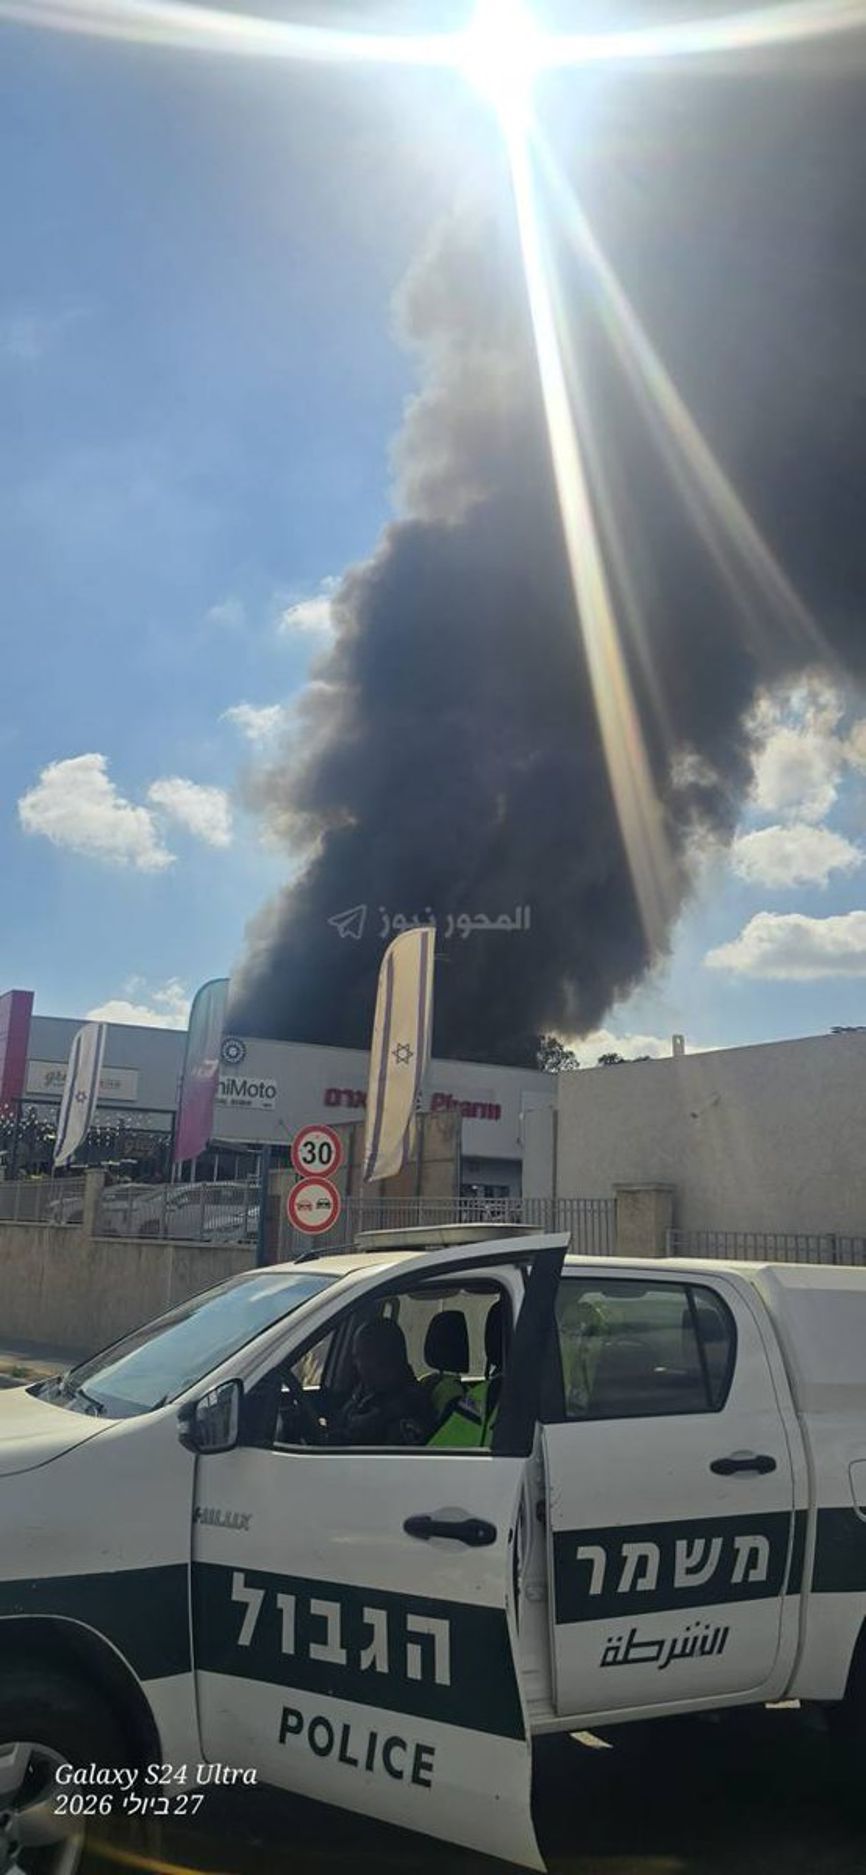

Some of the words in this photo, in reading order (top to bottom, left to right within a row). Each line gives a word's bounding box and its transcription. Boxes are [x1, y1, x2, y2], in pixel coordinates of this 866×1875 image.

[218, 1079, 276, 1099] niMoto
[325, 1088, 368, 1108] ארם
[302, 1141, 332, 1165] 30
[576, 1534, 770, 1596] משמר
[231, 1571, 451, 1687] הגבול
[600, 1621, 730, 1670] الشرطة
[279, 1705, 436, 1788] POLICE
